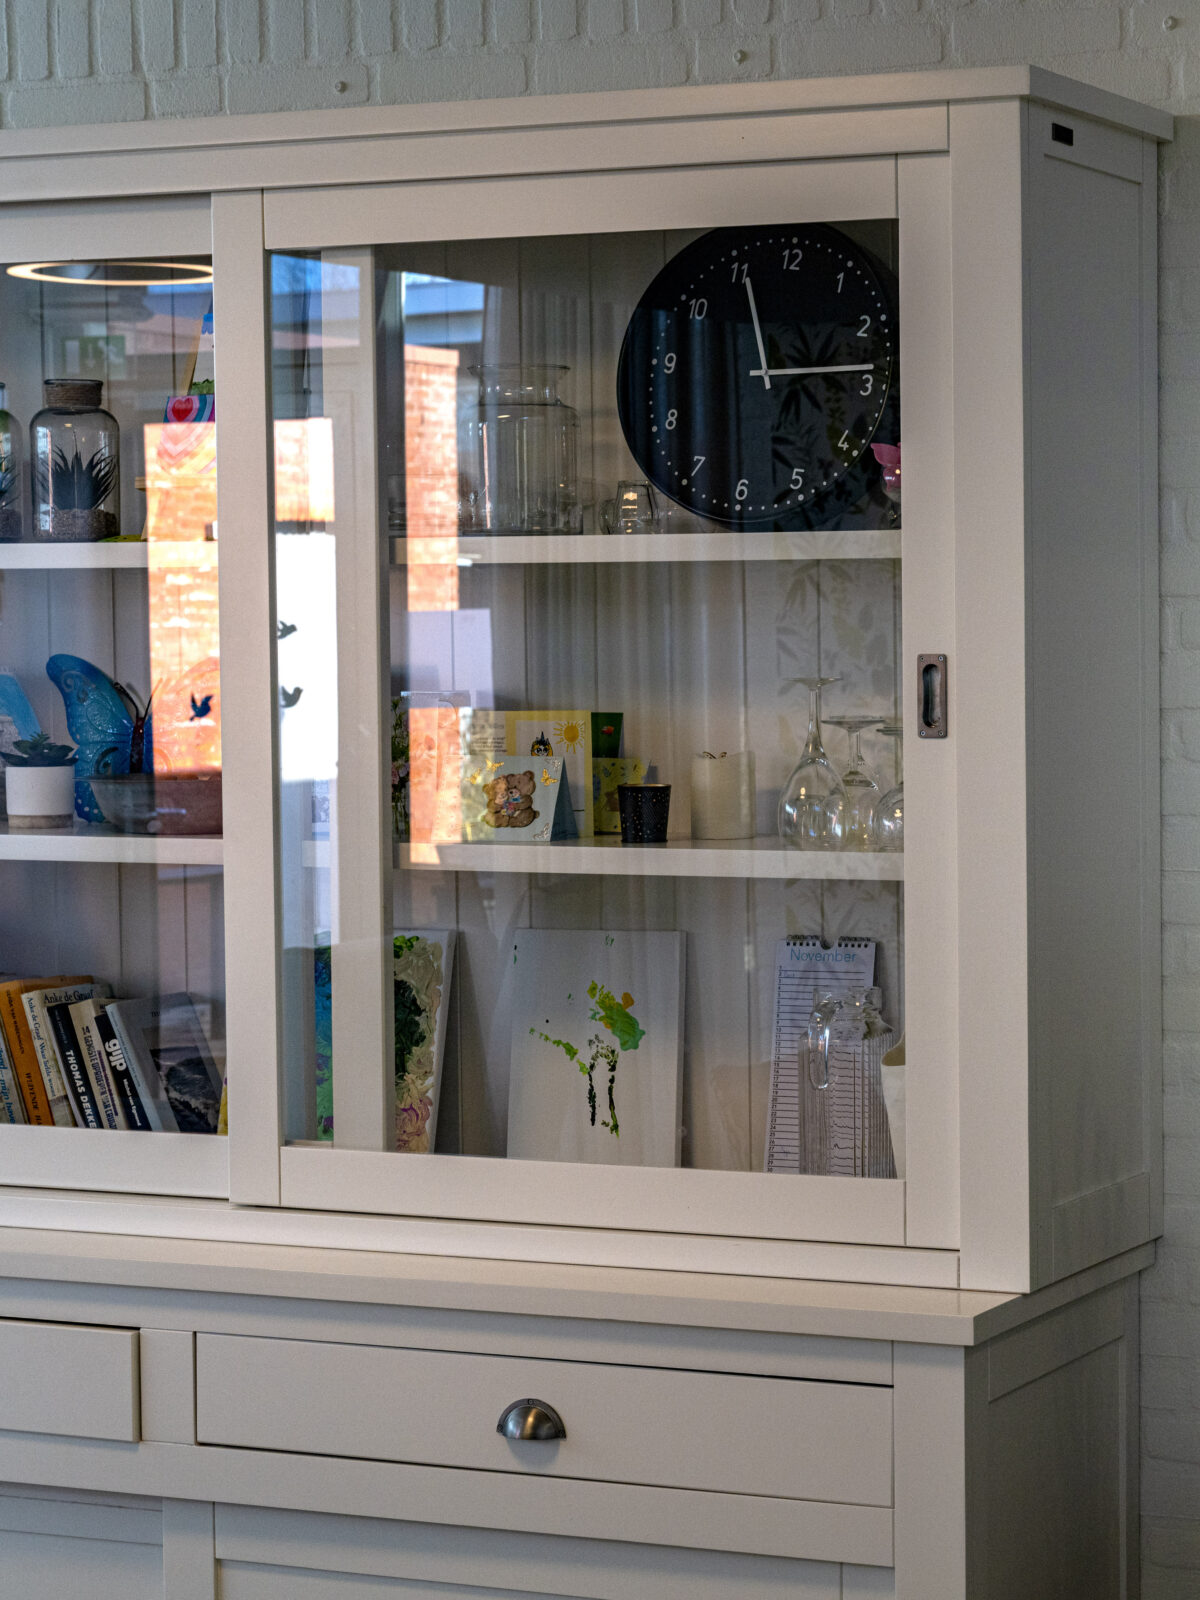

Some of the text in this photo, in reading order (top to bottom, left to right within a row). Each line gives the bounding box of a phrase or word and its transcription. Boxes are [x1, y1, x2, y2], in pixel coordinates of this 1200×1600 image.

[782, 249, 802, 270] 12
[731, 262, 749, 284] 11
[836, 272, 844, 293] 1
[689, 298, 708, 320] 10
[857, 315, 871, 337] 2
[663, 353, 677, 374] 9
[860, 374, 873, 396] 3
[665, 409, 678, 430] 8
[837, 430, 849, 450] 4
[691, 455, 705, 476] 7
[735, 479, 749, 501] 6
[790, 468, 805, 490] 5
[790, 948, 857, 963] November
[104, 1038, 128, 1072] gijp
[65, 1049, 86, 1094] THOMAS
